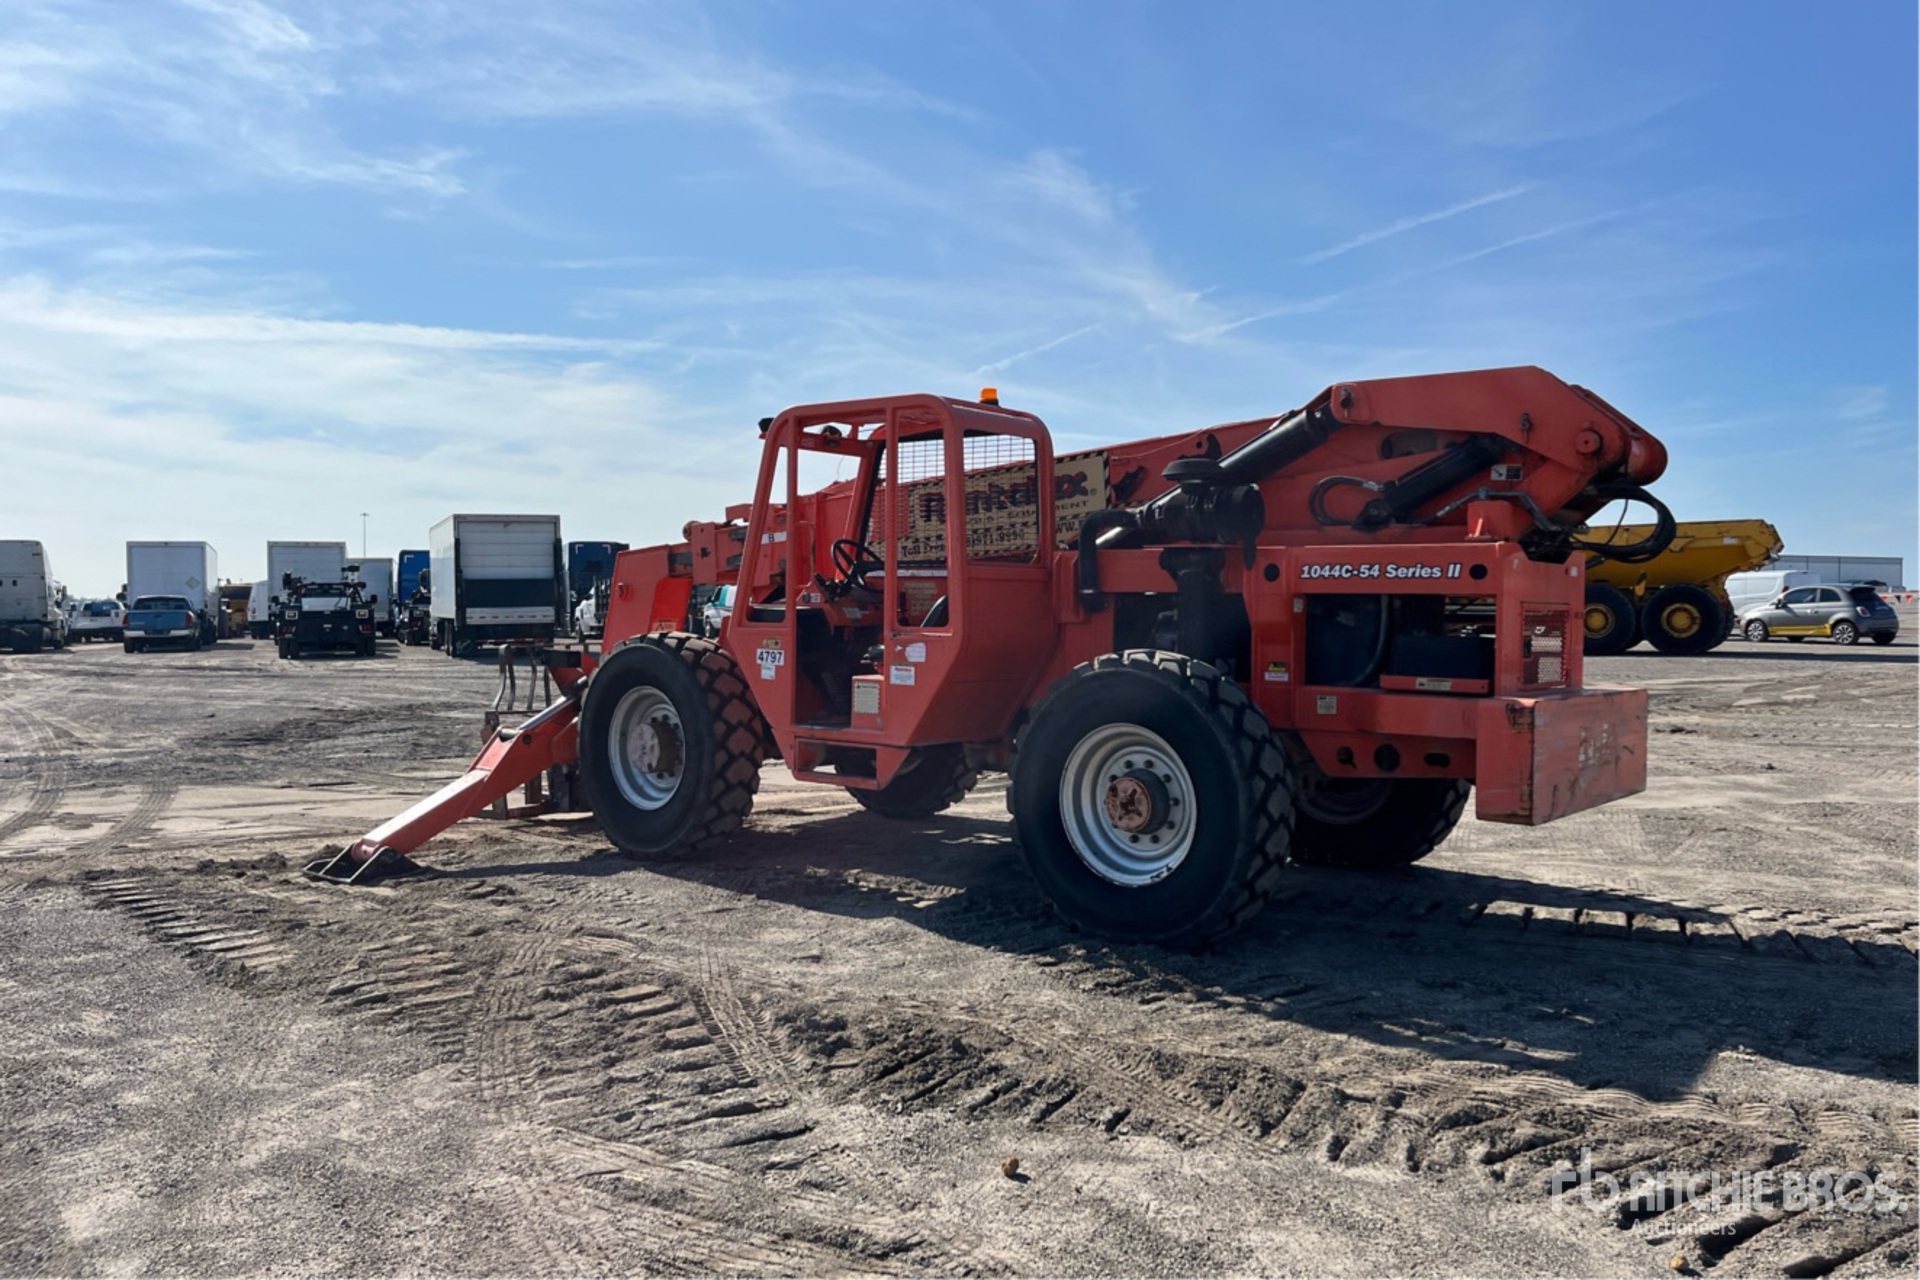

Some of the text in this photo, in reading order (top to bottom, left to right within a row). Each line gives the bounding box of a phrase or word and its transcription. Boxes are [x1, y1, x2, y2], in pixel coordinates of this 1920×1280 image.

[1300, 563, 1461, 578] 1044C-54 Series II
[758, 650, 783, 664] 4797
